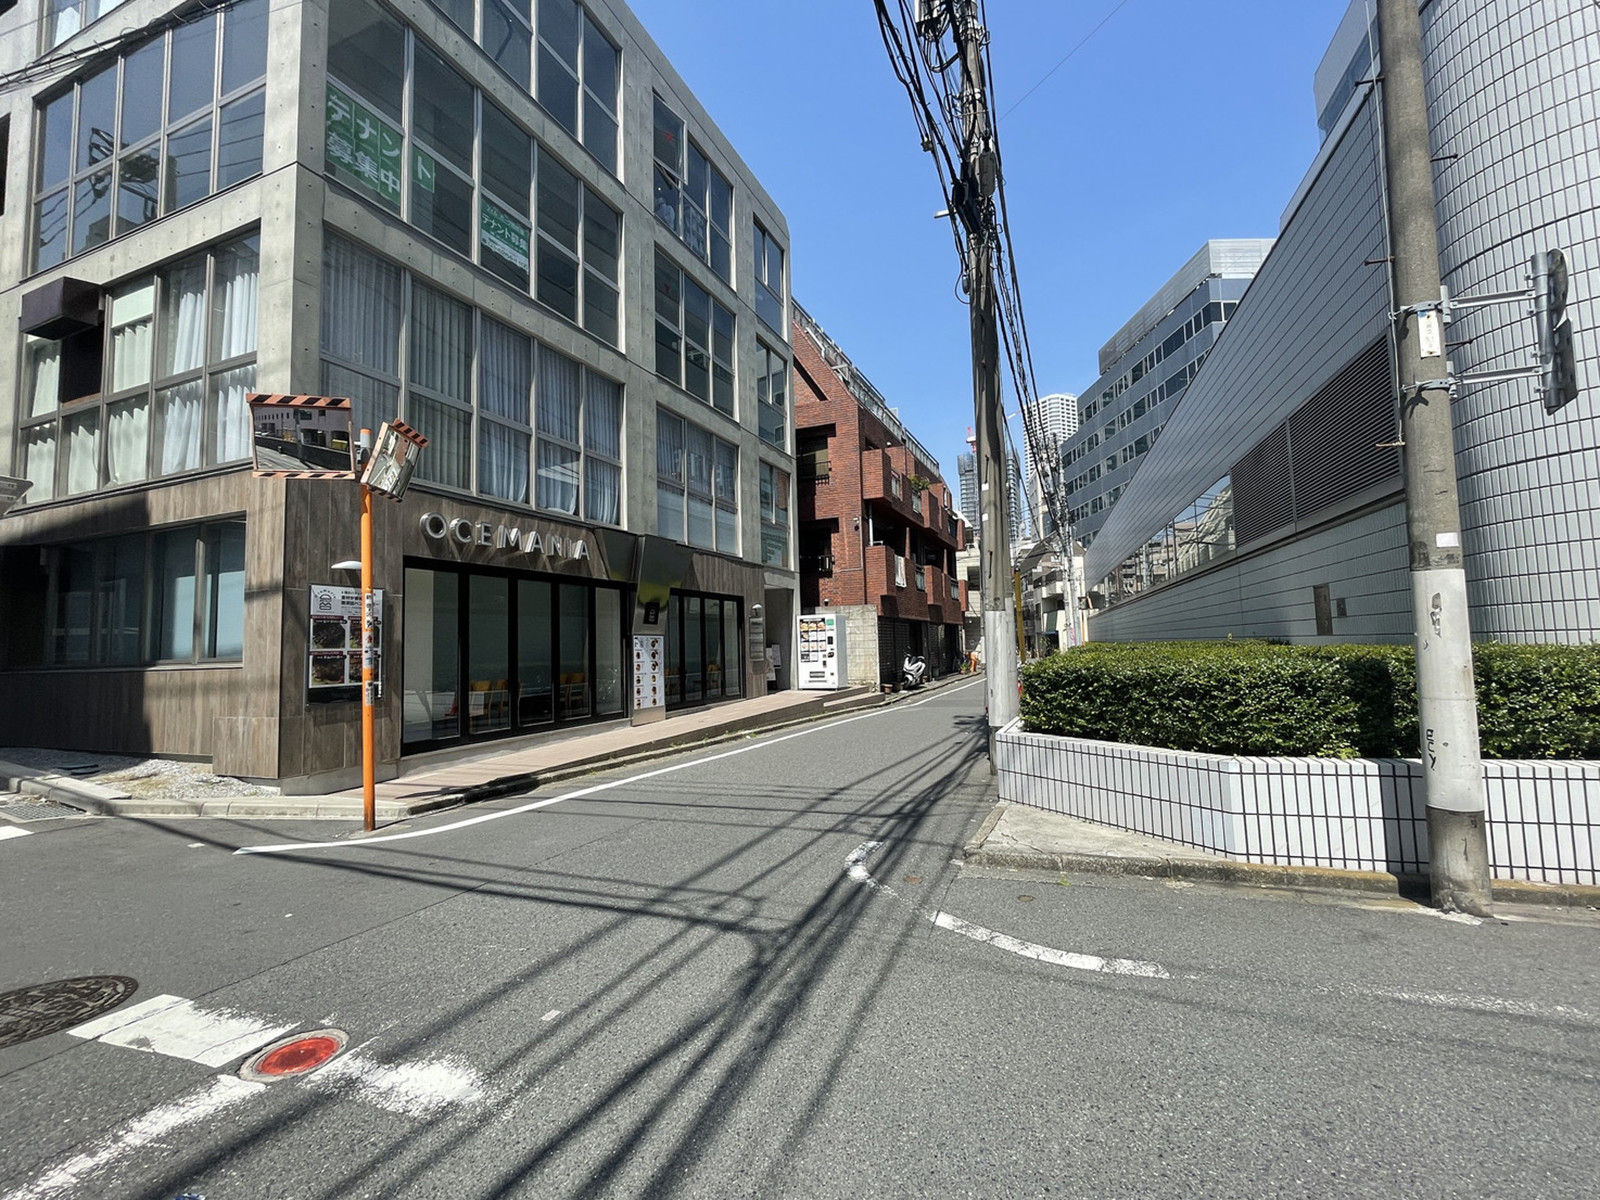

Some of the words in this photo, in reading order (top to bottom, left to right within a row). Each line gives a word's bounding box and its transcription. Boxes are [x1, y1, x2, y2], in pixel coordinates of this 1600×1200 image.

[327, 131, 400, 193] 募集中
[328, 94, 432, 180] テナント
[419, 512, 590, 560] OCEMANIA
